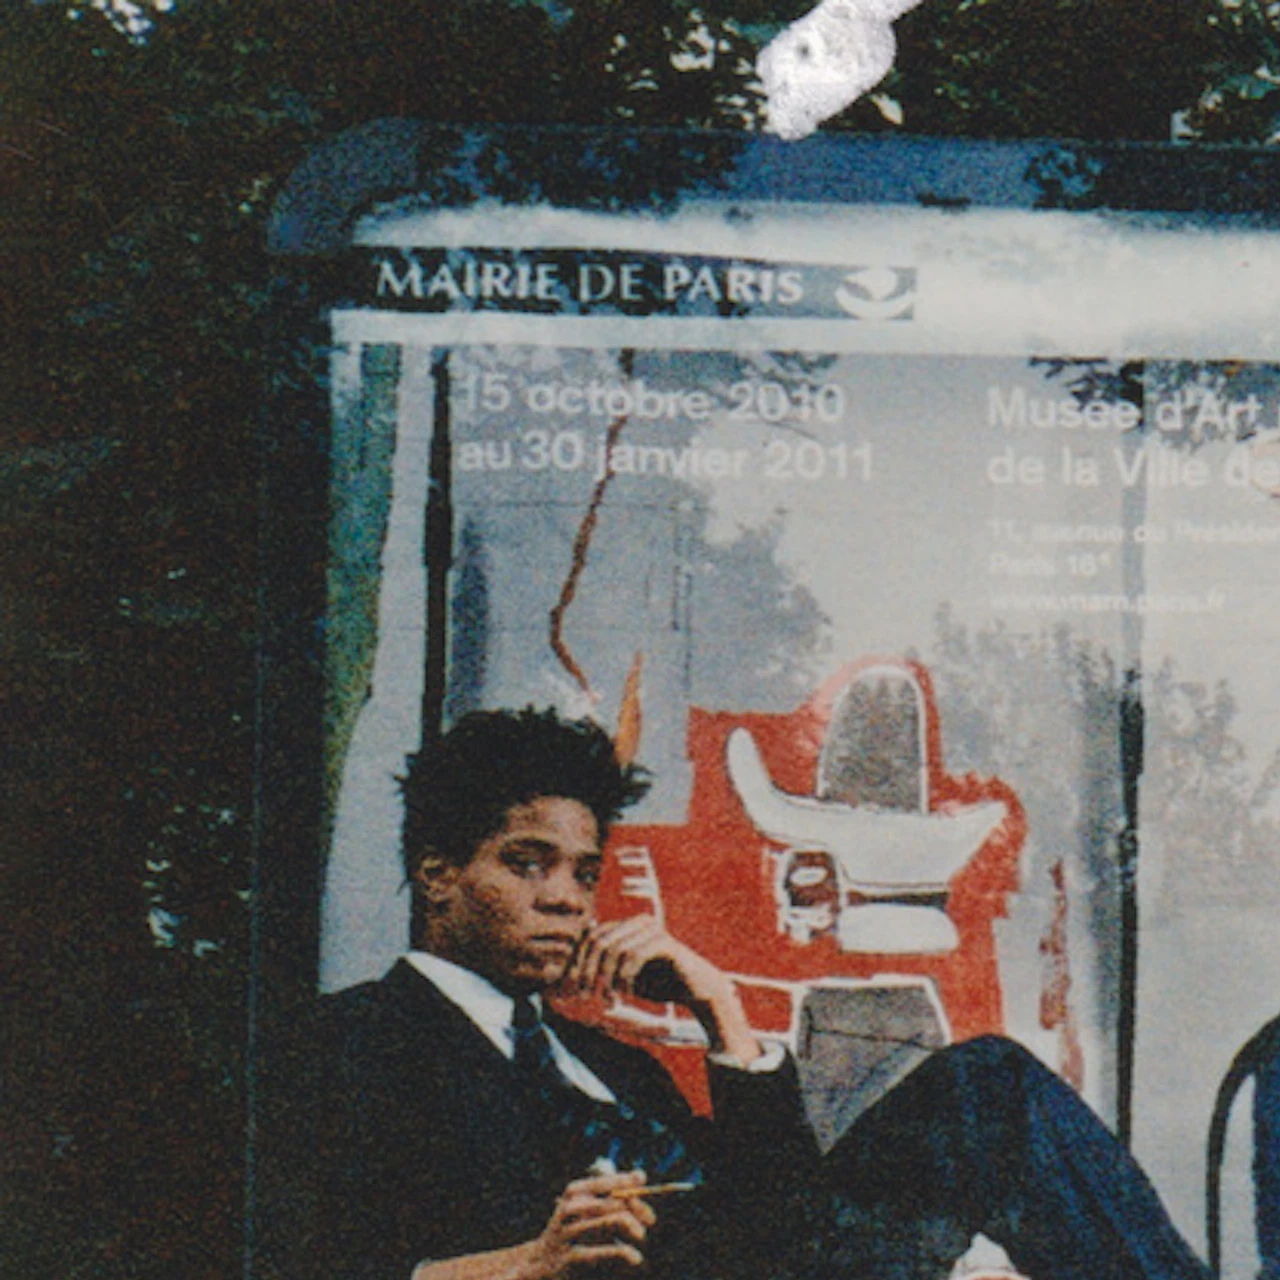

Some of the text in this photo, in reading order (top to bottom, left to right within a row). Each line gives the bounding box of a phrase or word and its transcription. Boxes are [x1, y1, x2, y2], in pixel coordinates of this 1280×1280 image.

[376, 262, 802, 302] MAIRIE DE PARIS
[460, 372, 846, 423] 15 octobre 2010
[457, 432, 875, 484] au 30 janvier 2011
[987, 446, 1046, 485] de
[1062, 446, 1100, 486] la
[1114, 446, 1211, 487] Ville
